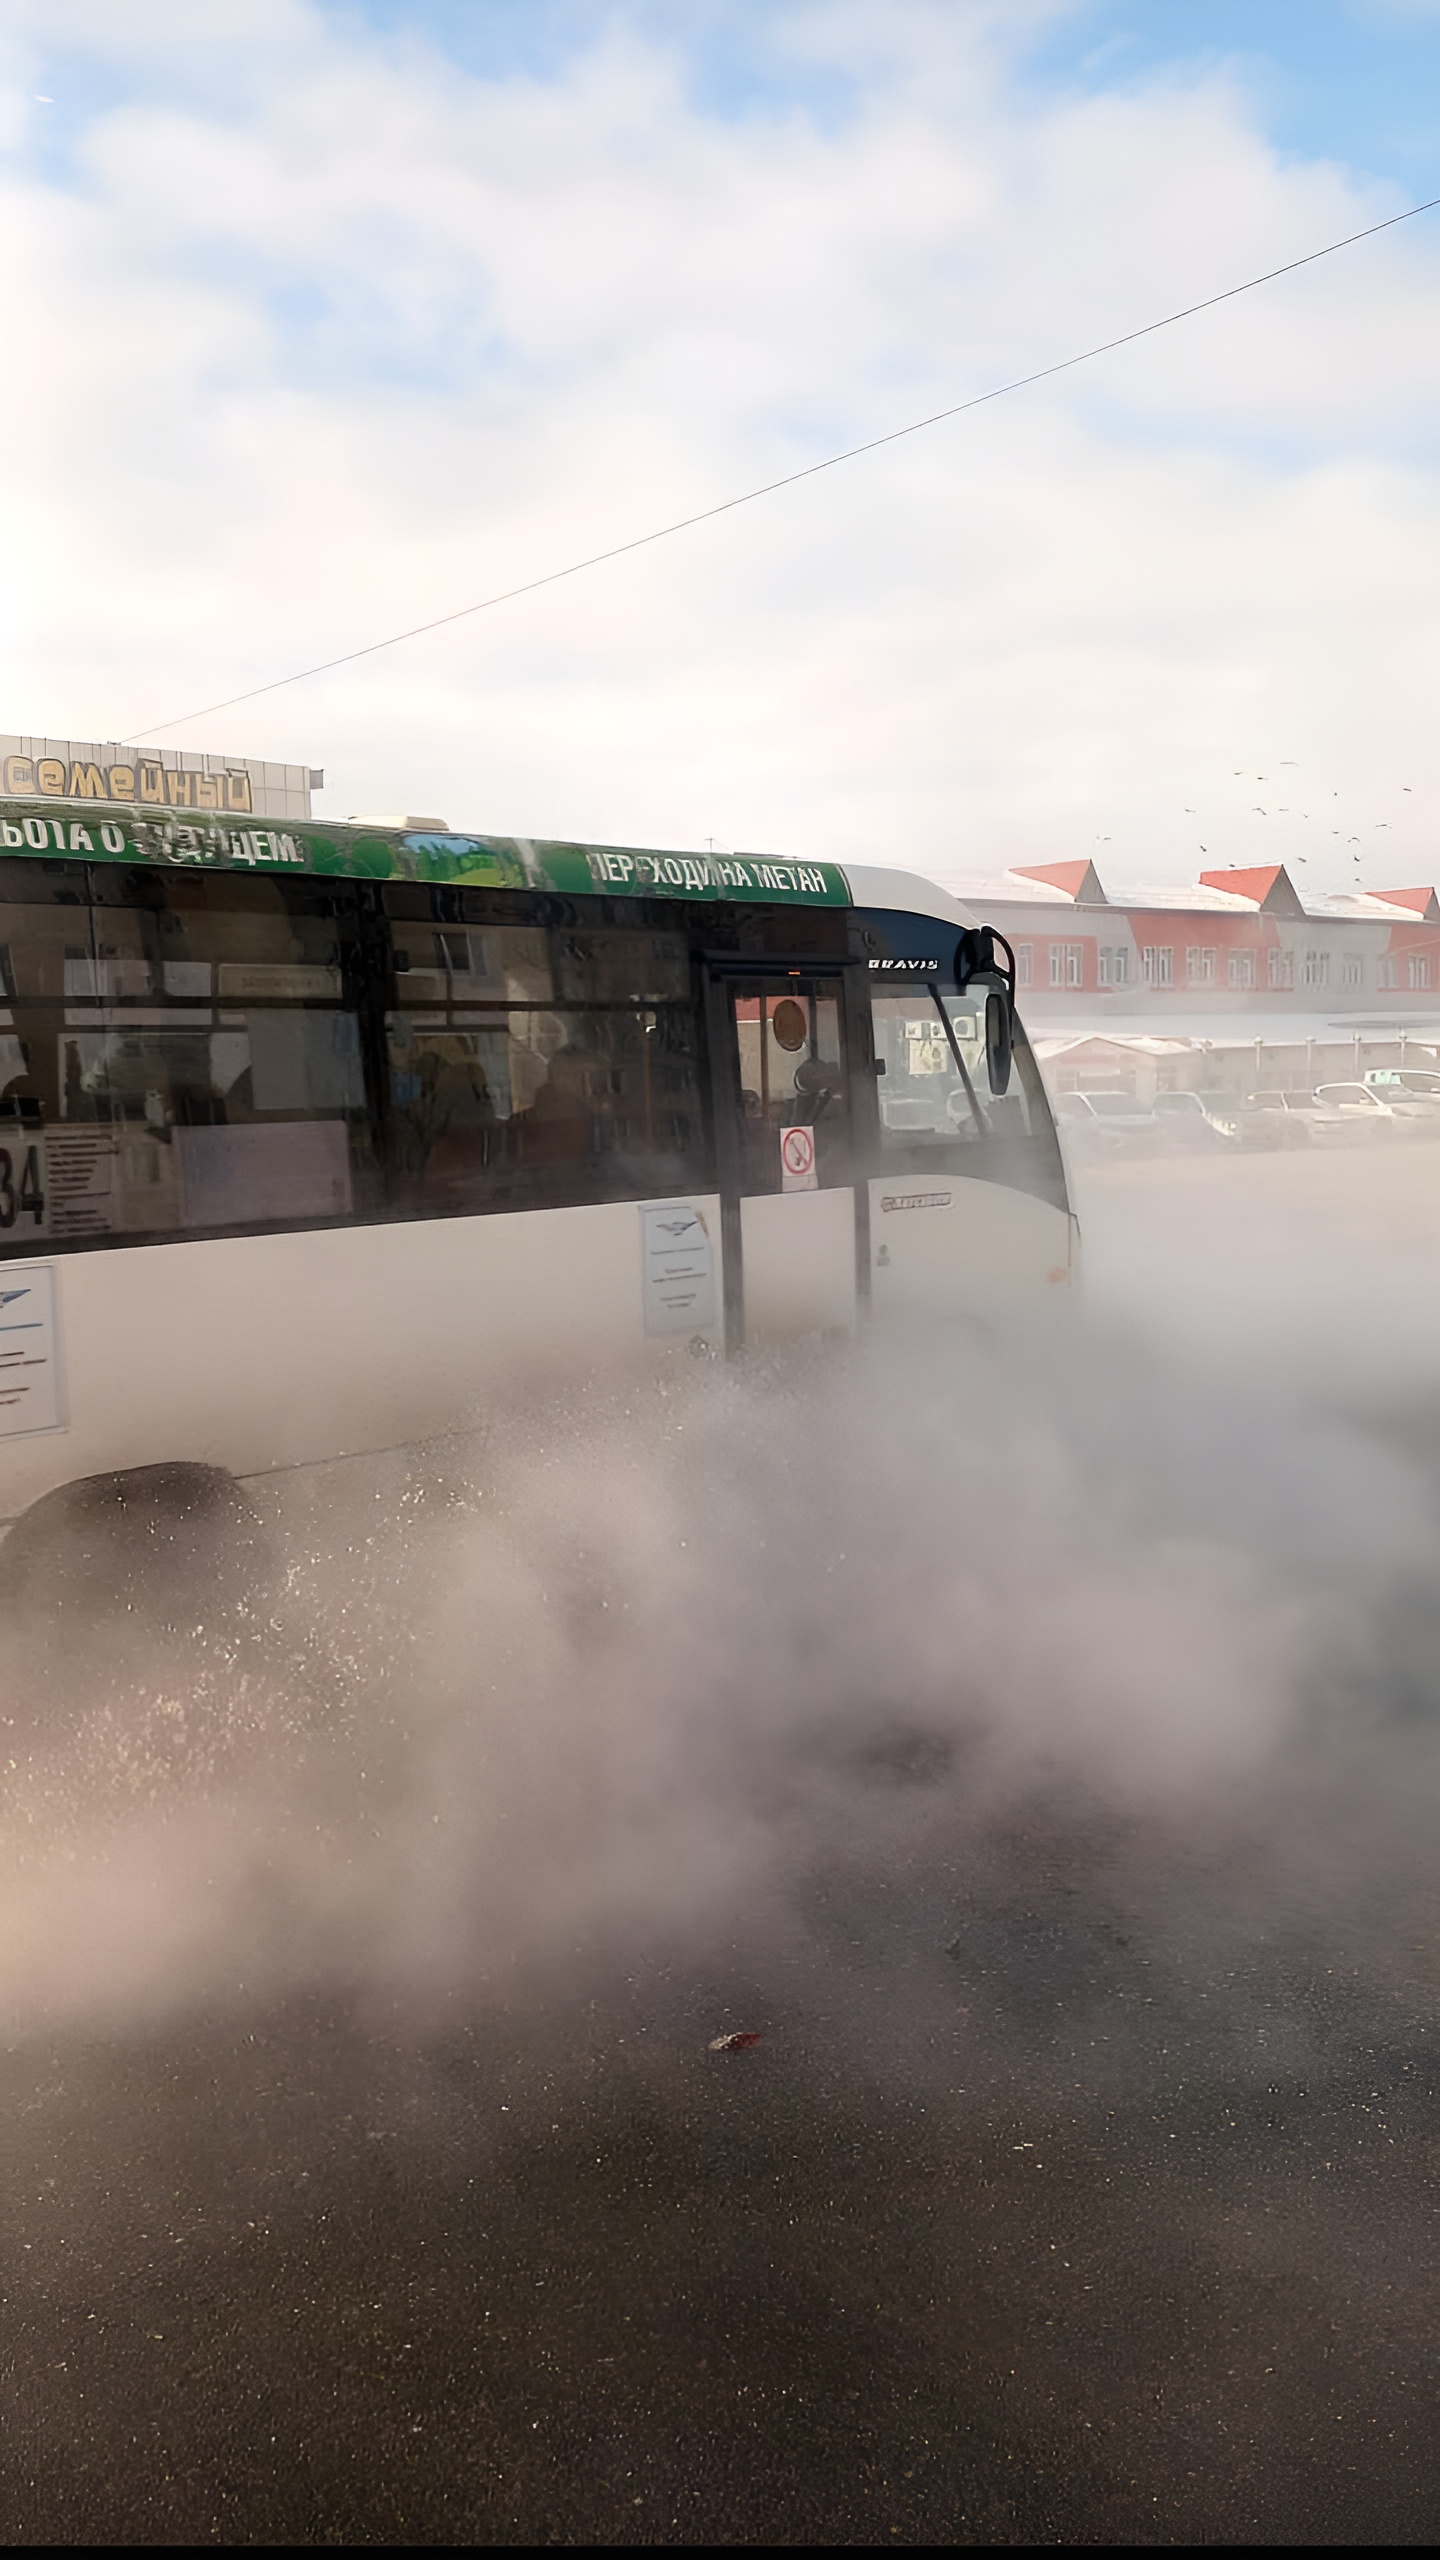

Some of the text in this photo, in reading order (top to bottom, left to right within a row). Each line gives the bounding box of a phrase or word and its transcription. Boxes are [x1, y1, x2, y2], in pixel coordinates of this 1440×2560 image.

[0, 818, 94, 851] БОТА
[750, 863, 828, 893] МЕТАН
[868, 959, 938, 970] BRAVIS
